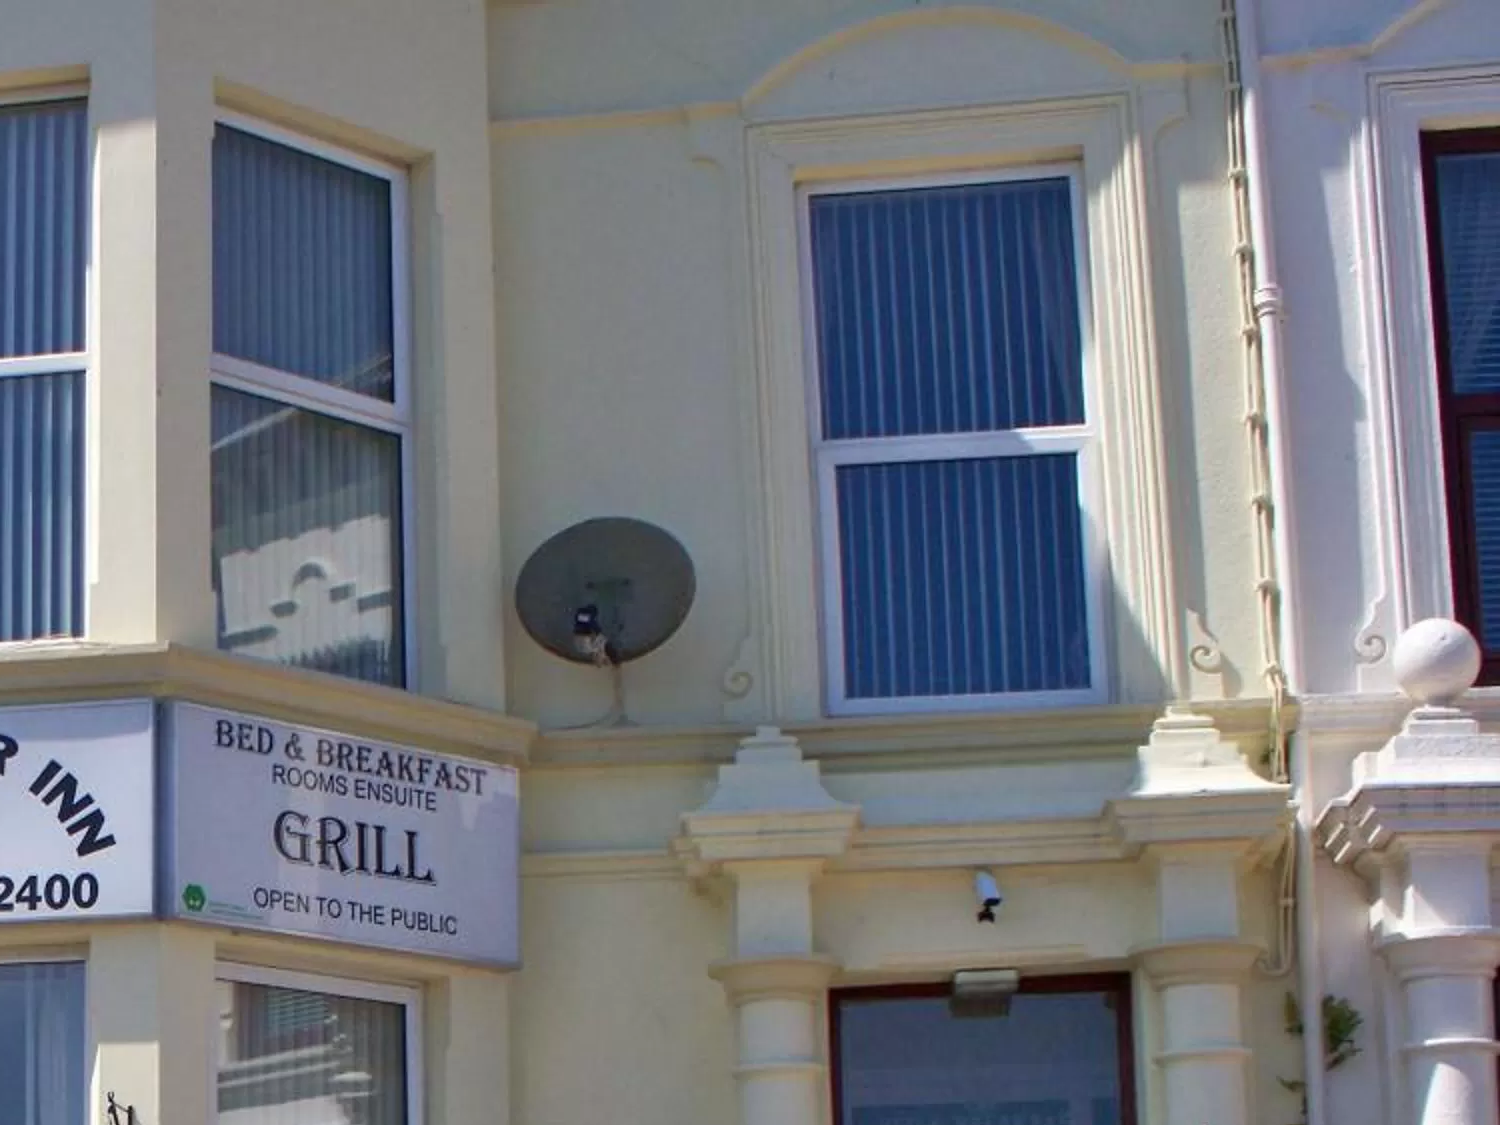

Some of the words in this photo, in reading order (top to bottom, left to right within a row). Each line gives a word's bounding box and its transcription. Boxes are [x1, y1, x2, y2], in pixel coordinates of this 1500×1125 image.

[215, 719, 274, 756] BED
[285, 732, 306, 762] &
[317, 739, 488, 796] BREAKFAST
[272, 763, 348, 797] ROOMS
[354, 778, 437, 812] ENSUITE
[28, 759, 117, 857] INN
[273, 809, 436, 887] GRILL
[253, 886, 310, 914] OPEN
[316, 896, 342, 919] TO
[348, 901, 385, 926] THE
[391, 908, 459, 936] PUBLIC
